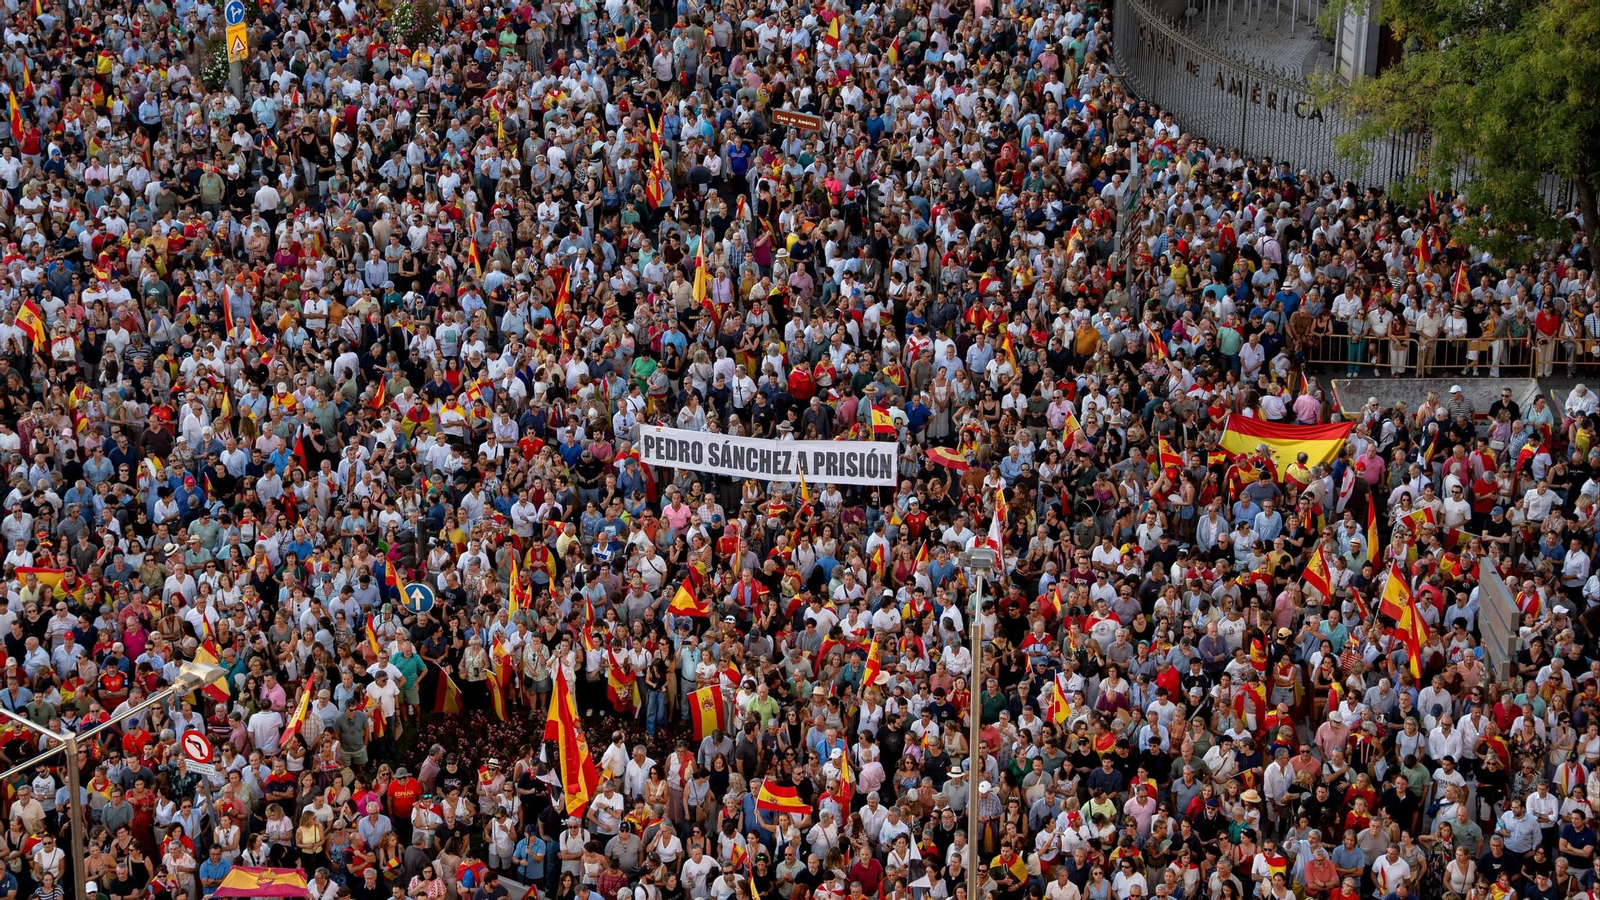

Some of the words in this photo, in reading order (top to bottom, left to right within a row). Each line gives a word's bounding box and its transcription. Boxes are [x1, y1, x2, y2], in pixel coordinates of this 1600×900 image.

[1186, 60, 1200, 78] DE
[776, 114, 789, 122] Casa
[797, 118, 817, 127] América
[644, 434, 704, 465] PEDRO
[708, 440, 792, 475] SÁNCHEZ
[795, 451, 809, 475] A
[813, 448, 892, 479] PRISIÓN
